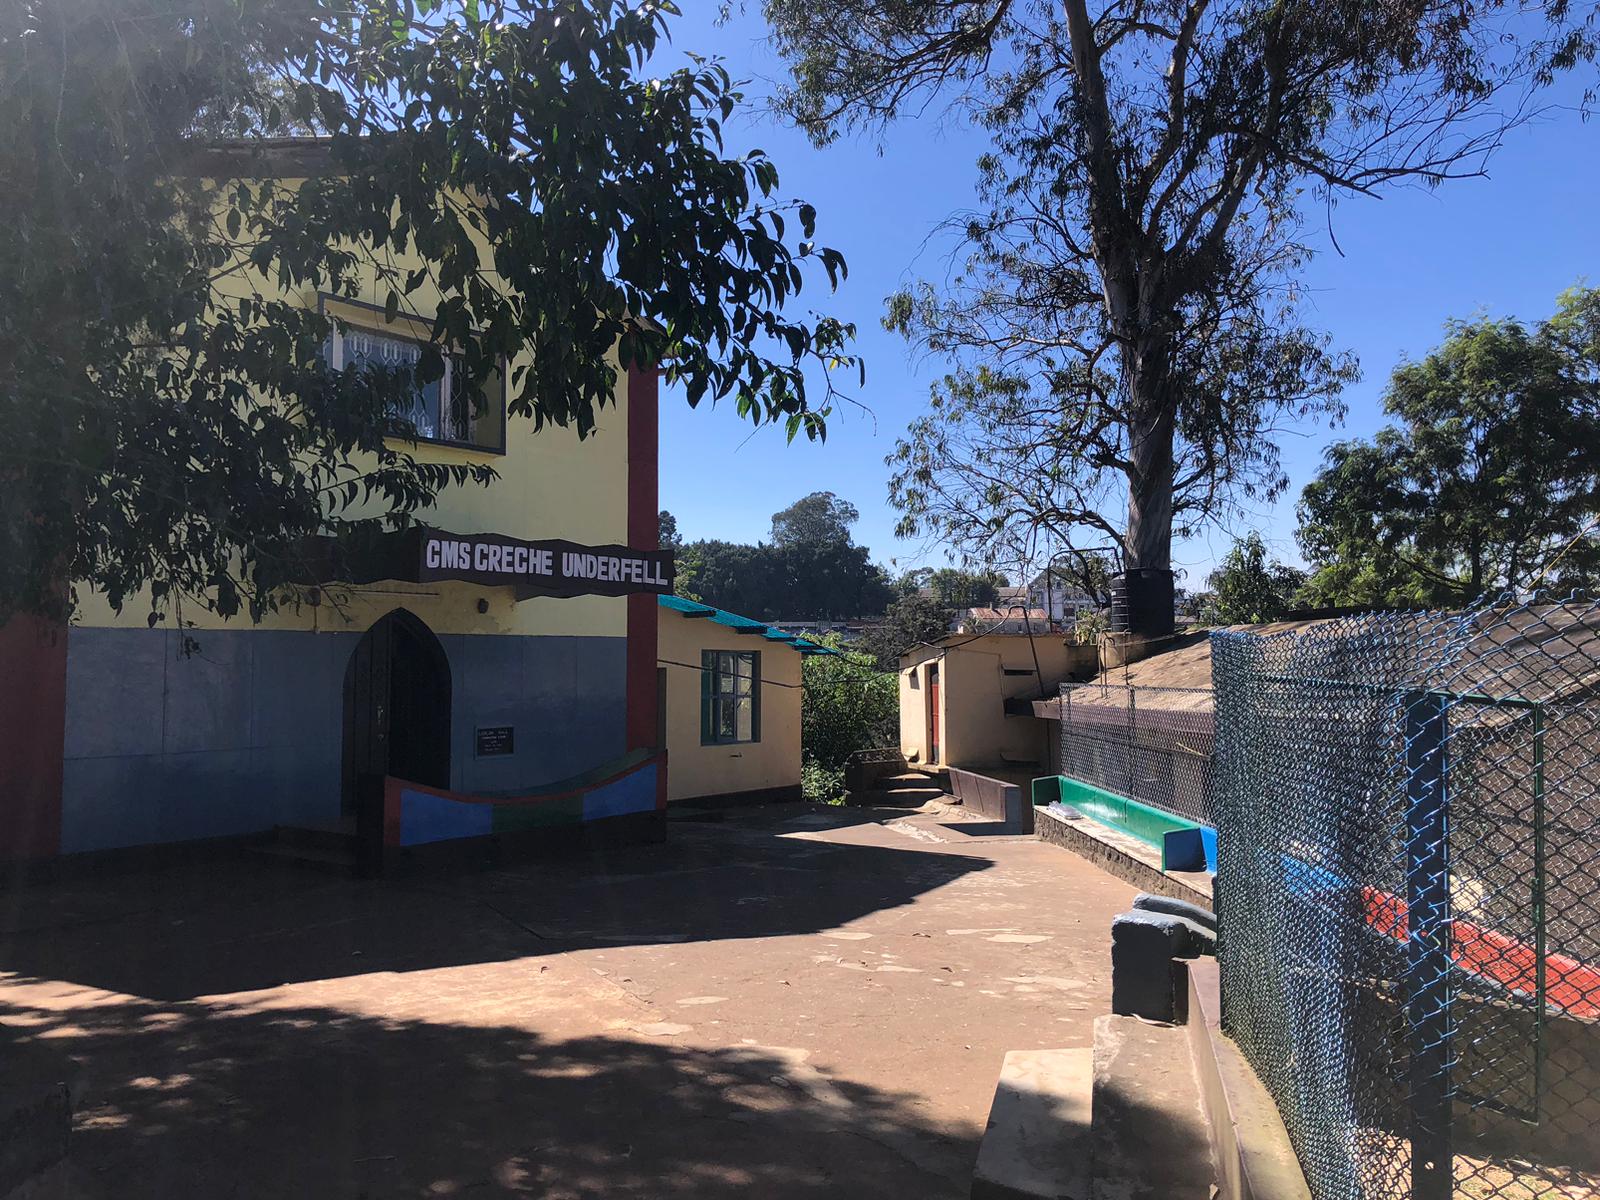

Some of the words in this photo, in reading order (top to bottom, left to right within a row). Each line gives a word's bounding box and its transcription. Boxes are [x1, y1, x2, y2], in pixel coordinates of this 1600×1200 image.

[426, 539, 471, 569] CMS
[474, 543, 553, 576] CRECHE
[562, 552, 668, 586] UNDERFELL
